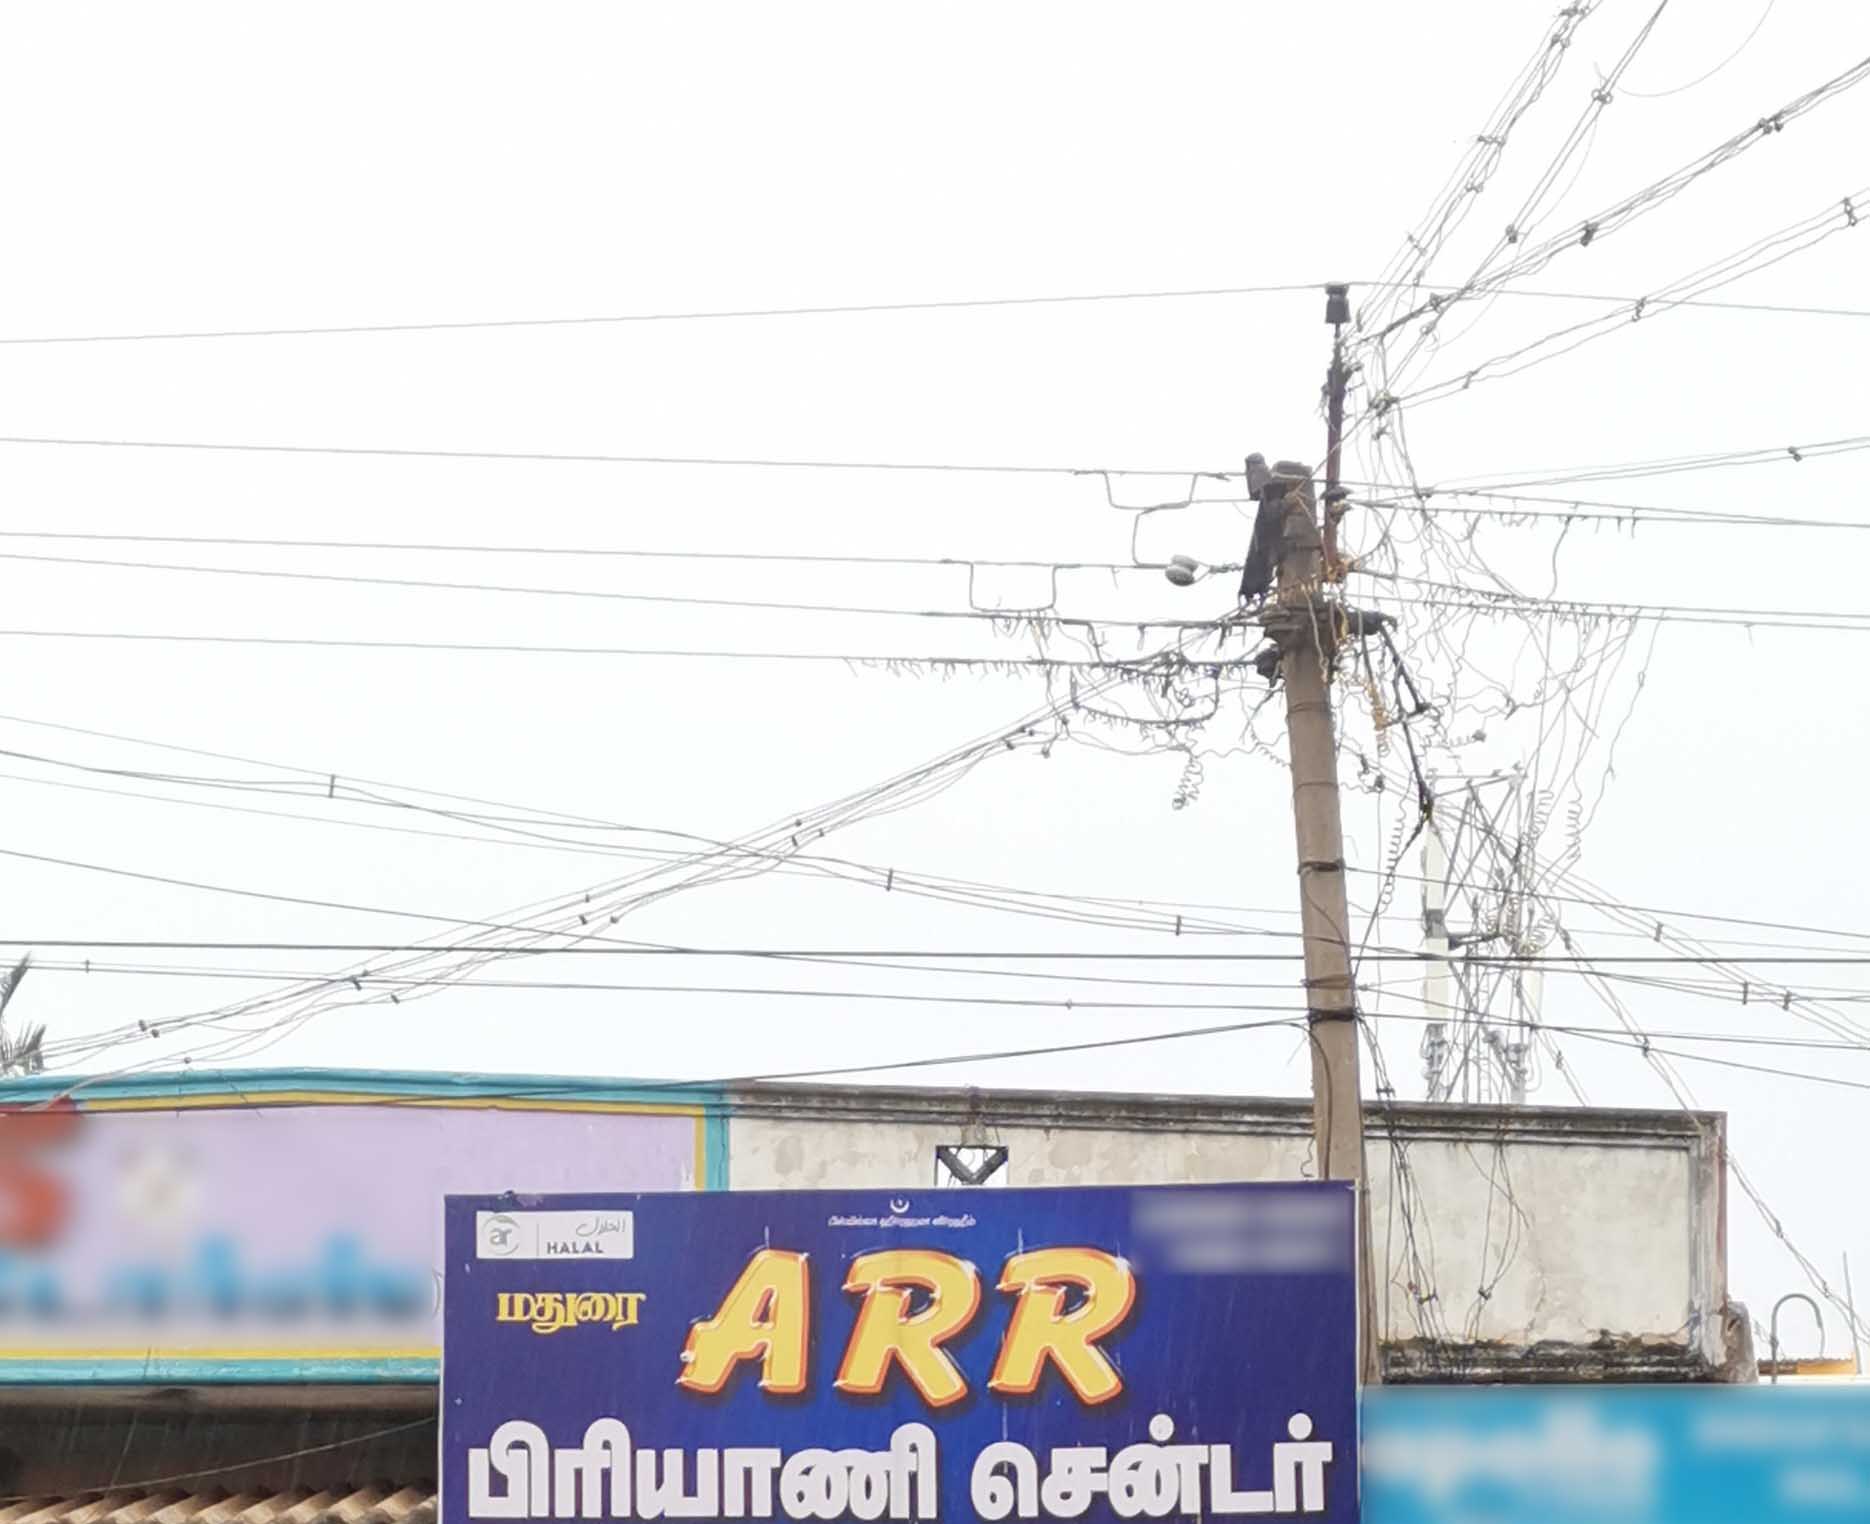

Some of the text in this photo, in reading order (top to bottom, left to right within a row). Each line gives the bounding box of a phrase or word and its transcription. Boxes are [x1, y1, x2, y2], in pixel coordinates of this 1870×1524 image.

[546, 1241, 604, 1254] HALAL
[496, 1291, 648, 1333] மதுரை
[468, 1417, 937, 1520] பிரியாணி
[970, 1412, 1333, 1521] சென்டர்
